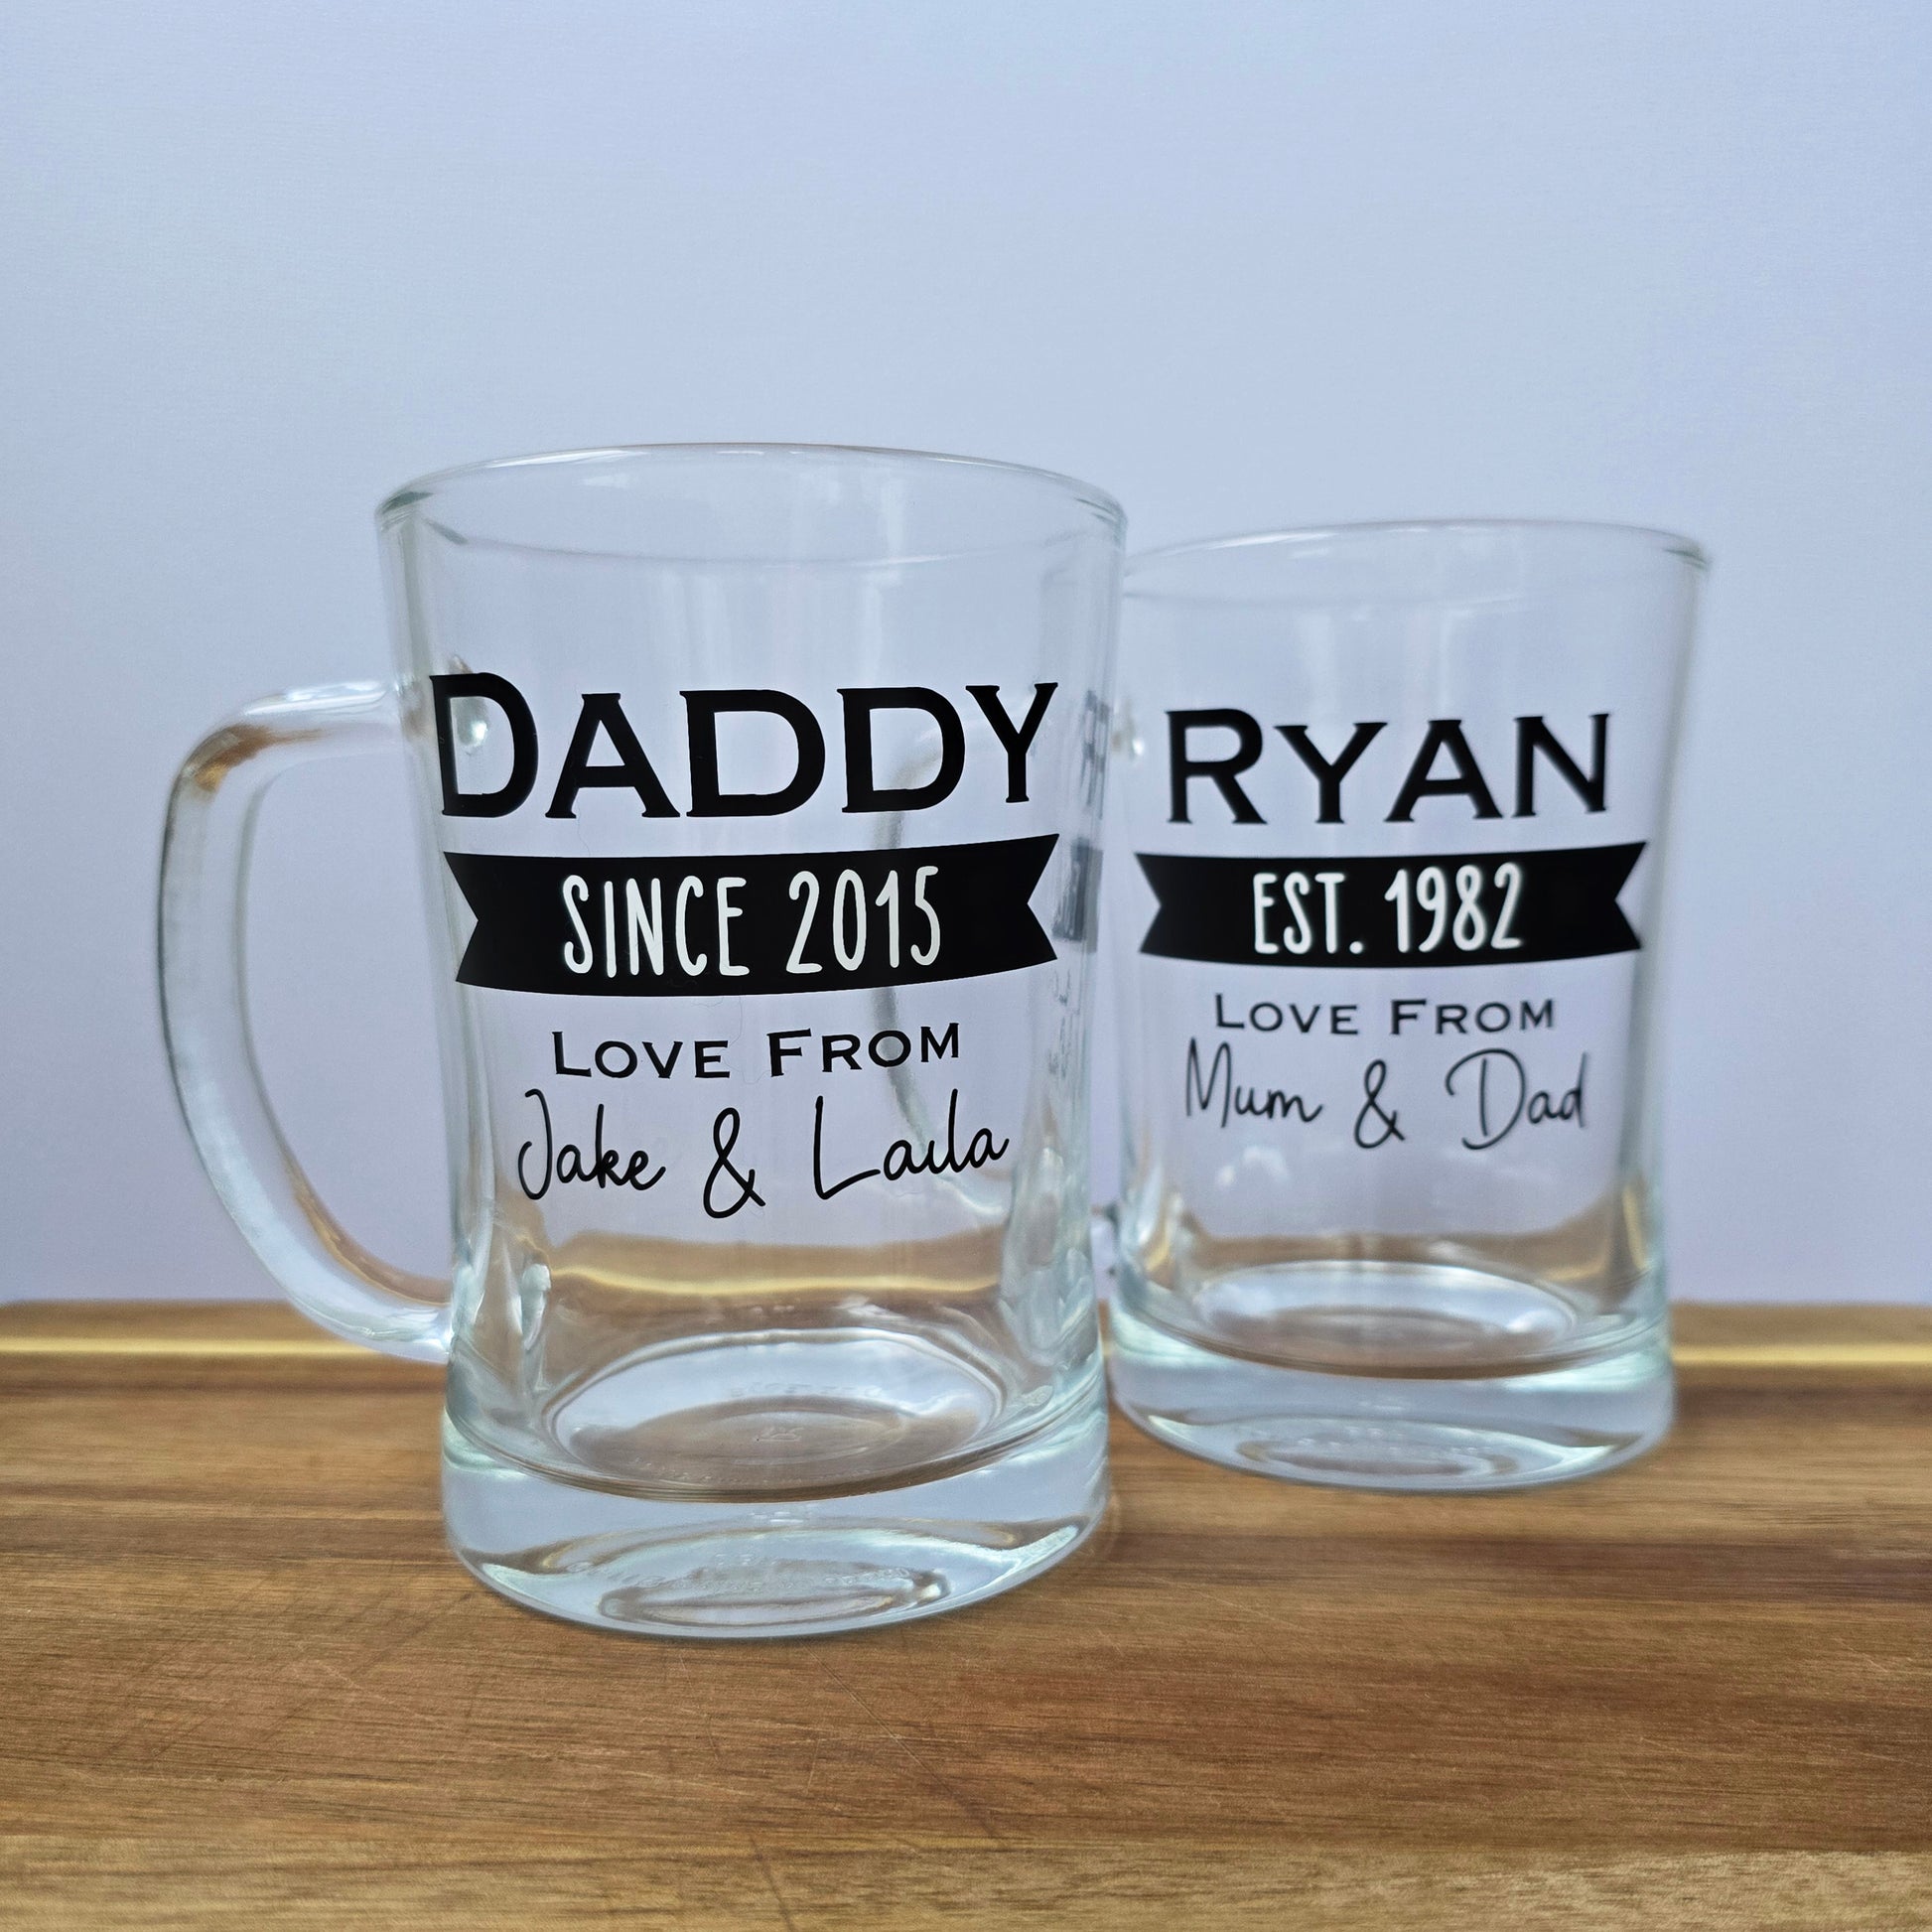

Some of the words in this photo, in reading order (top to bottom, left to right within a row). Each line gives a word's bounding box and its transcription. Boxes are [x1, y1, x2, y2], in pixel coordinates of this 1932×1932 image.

[429, 672, 1058, 818] DADDY
[1165, 708, 1609, 825] RYAN
[562, 874, 751, 978] SINCE
[785, 865, 941, 973] 2015
[1253, 871, 1364, 954] EST.
[1384, 862, 1522, 953] 1982
[1185, 1037, 1323, 1129] Mum
[1353, 1058, 1406, 1151] &
[1445, 1047, 1588, 1151] Dad
[517, 1088, 667, 1201] Jake
[703, 1107, 766, 1219] &
